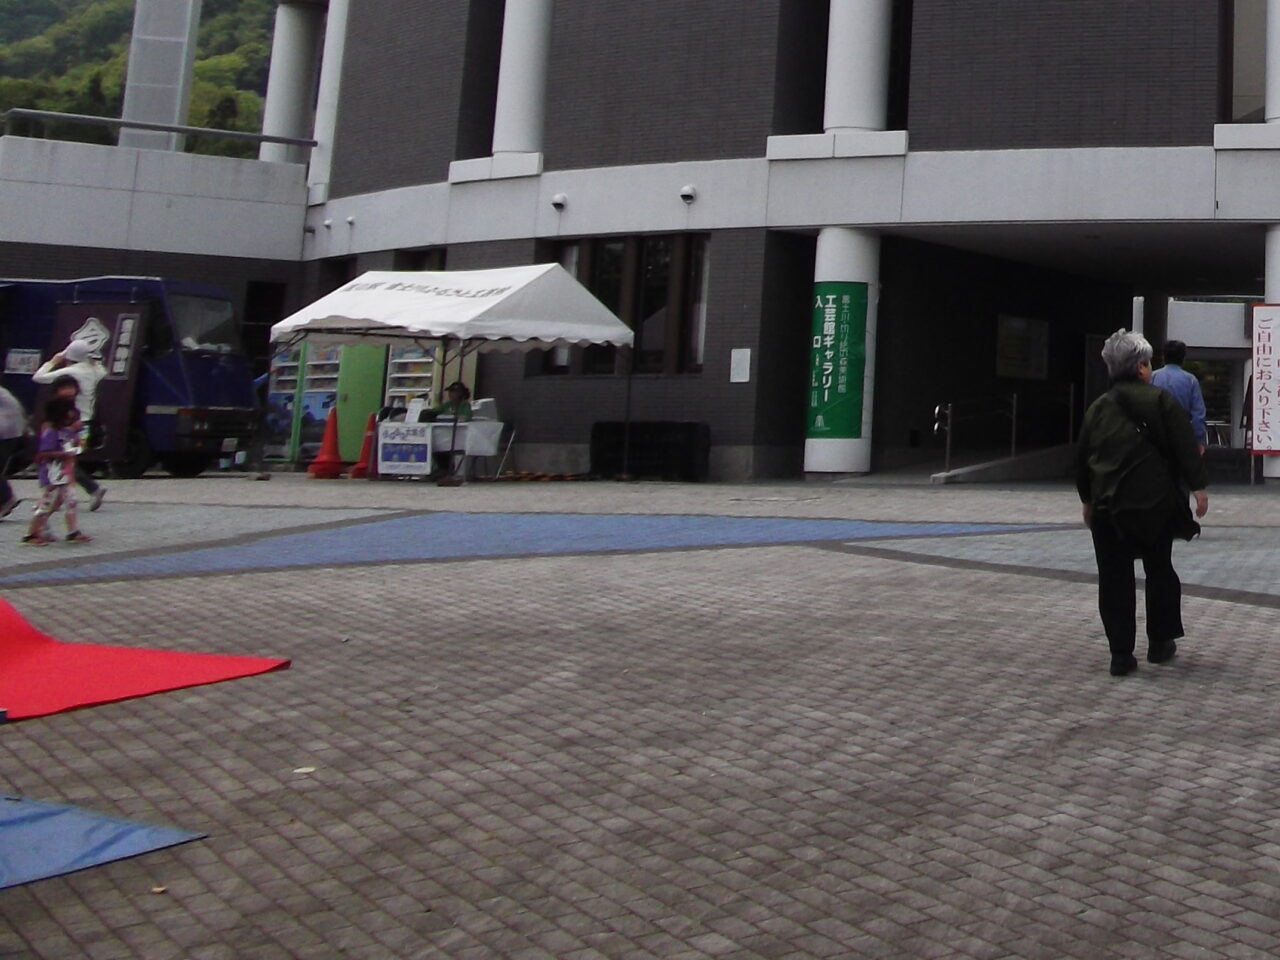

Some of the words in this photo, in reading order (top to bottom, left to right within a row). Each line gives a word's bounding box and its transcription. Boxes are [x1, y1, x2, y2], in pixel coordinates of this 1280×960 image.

[822, 295, 837, 402] 工芸館ギャラリー
